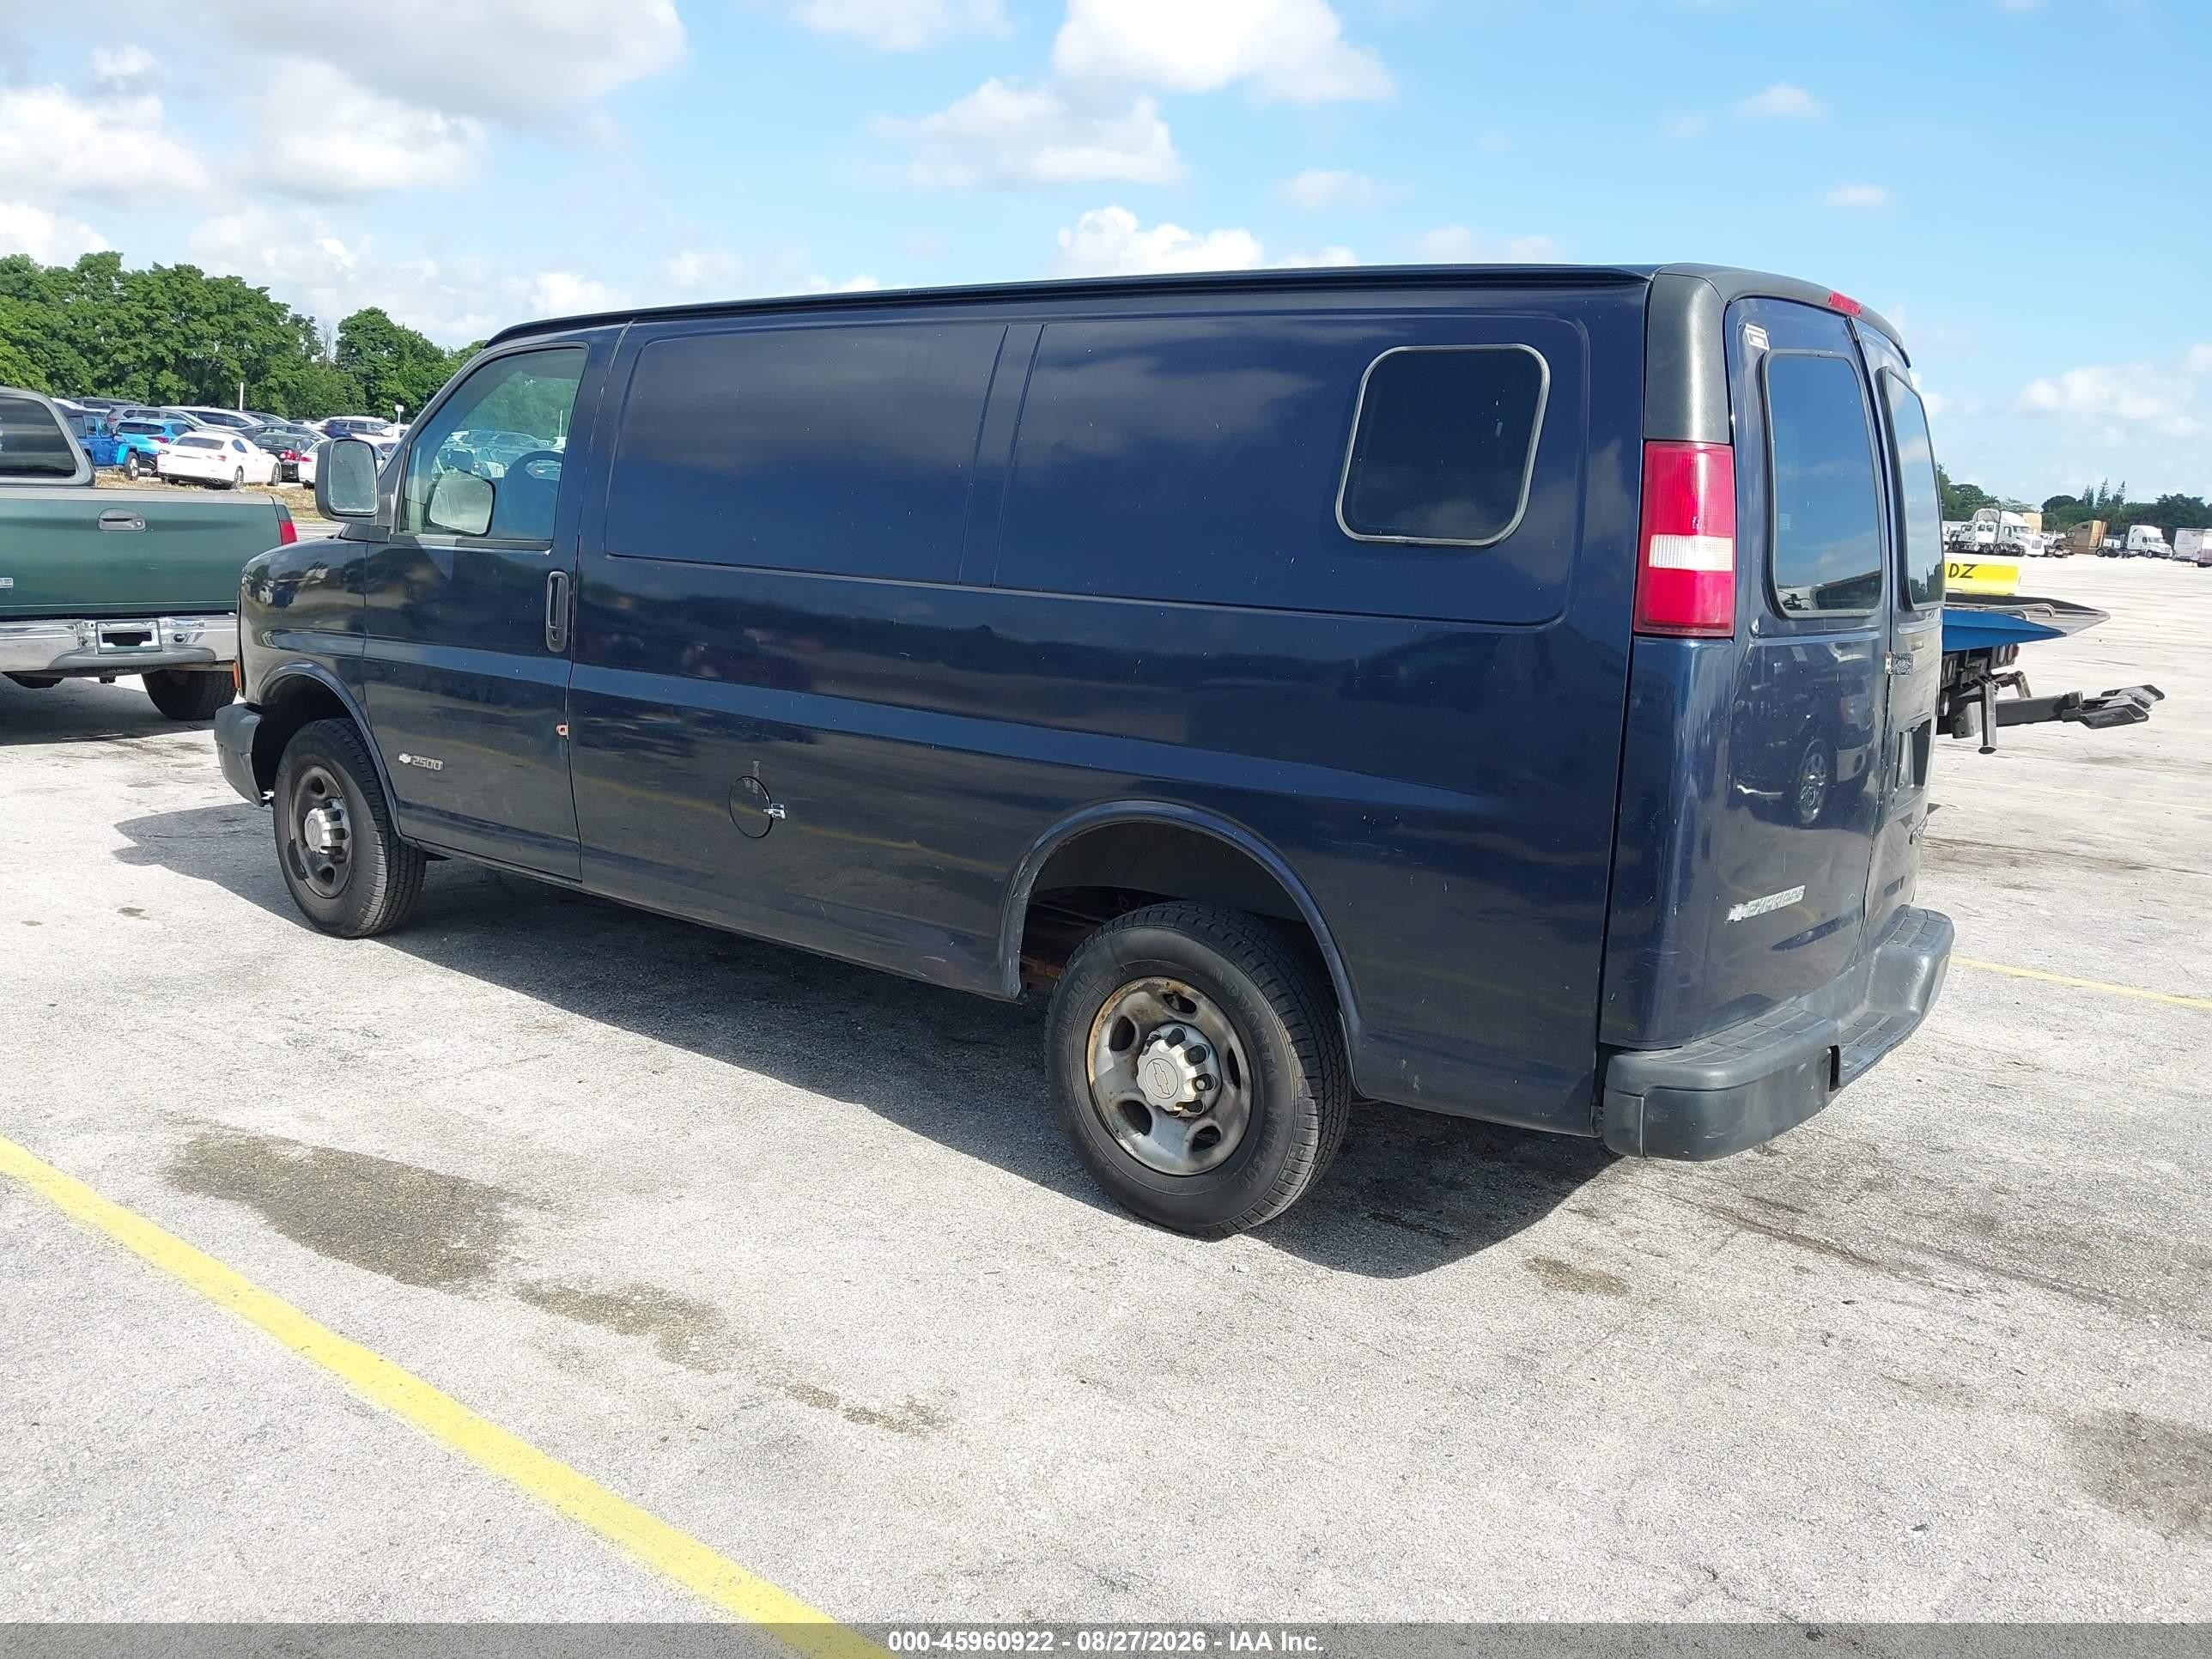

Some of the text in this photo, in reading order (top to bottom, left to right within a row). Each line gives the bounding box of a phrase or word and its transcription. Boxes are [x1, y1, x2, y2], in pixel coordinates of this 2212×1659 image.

[1948, 562, 1978, 579] DZ
[412, 755, 444, 771] 2500
[1745, 884, 1806, 919] EXPRESS
